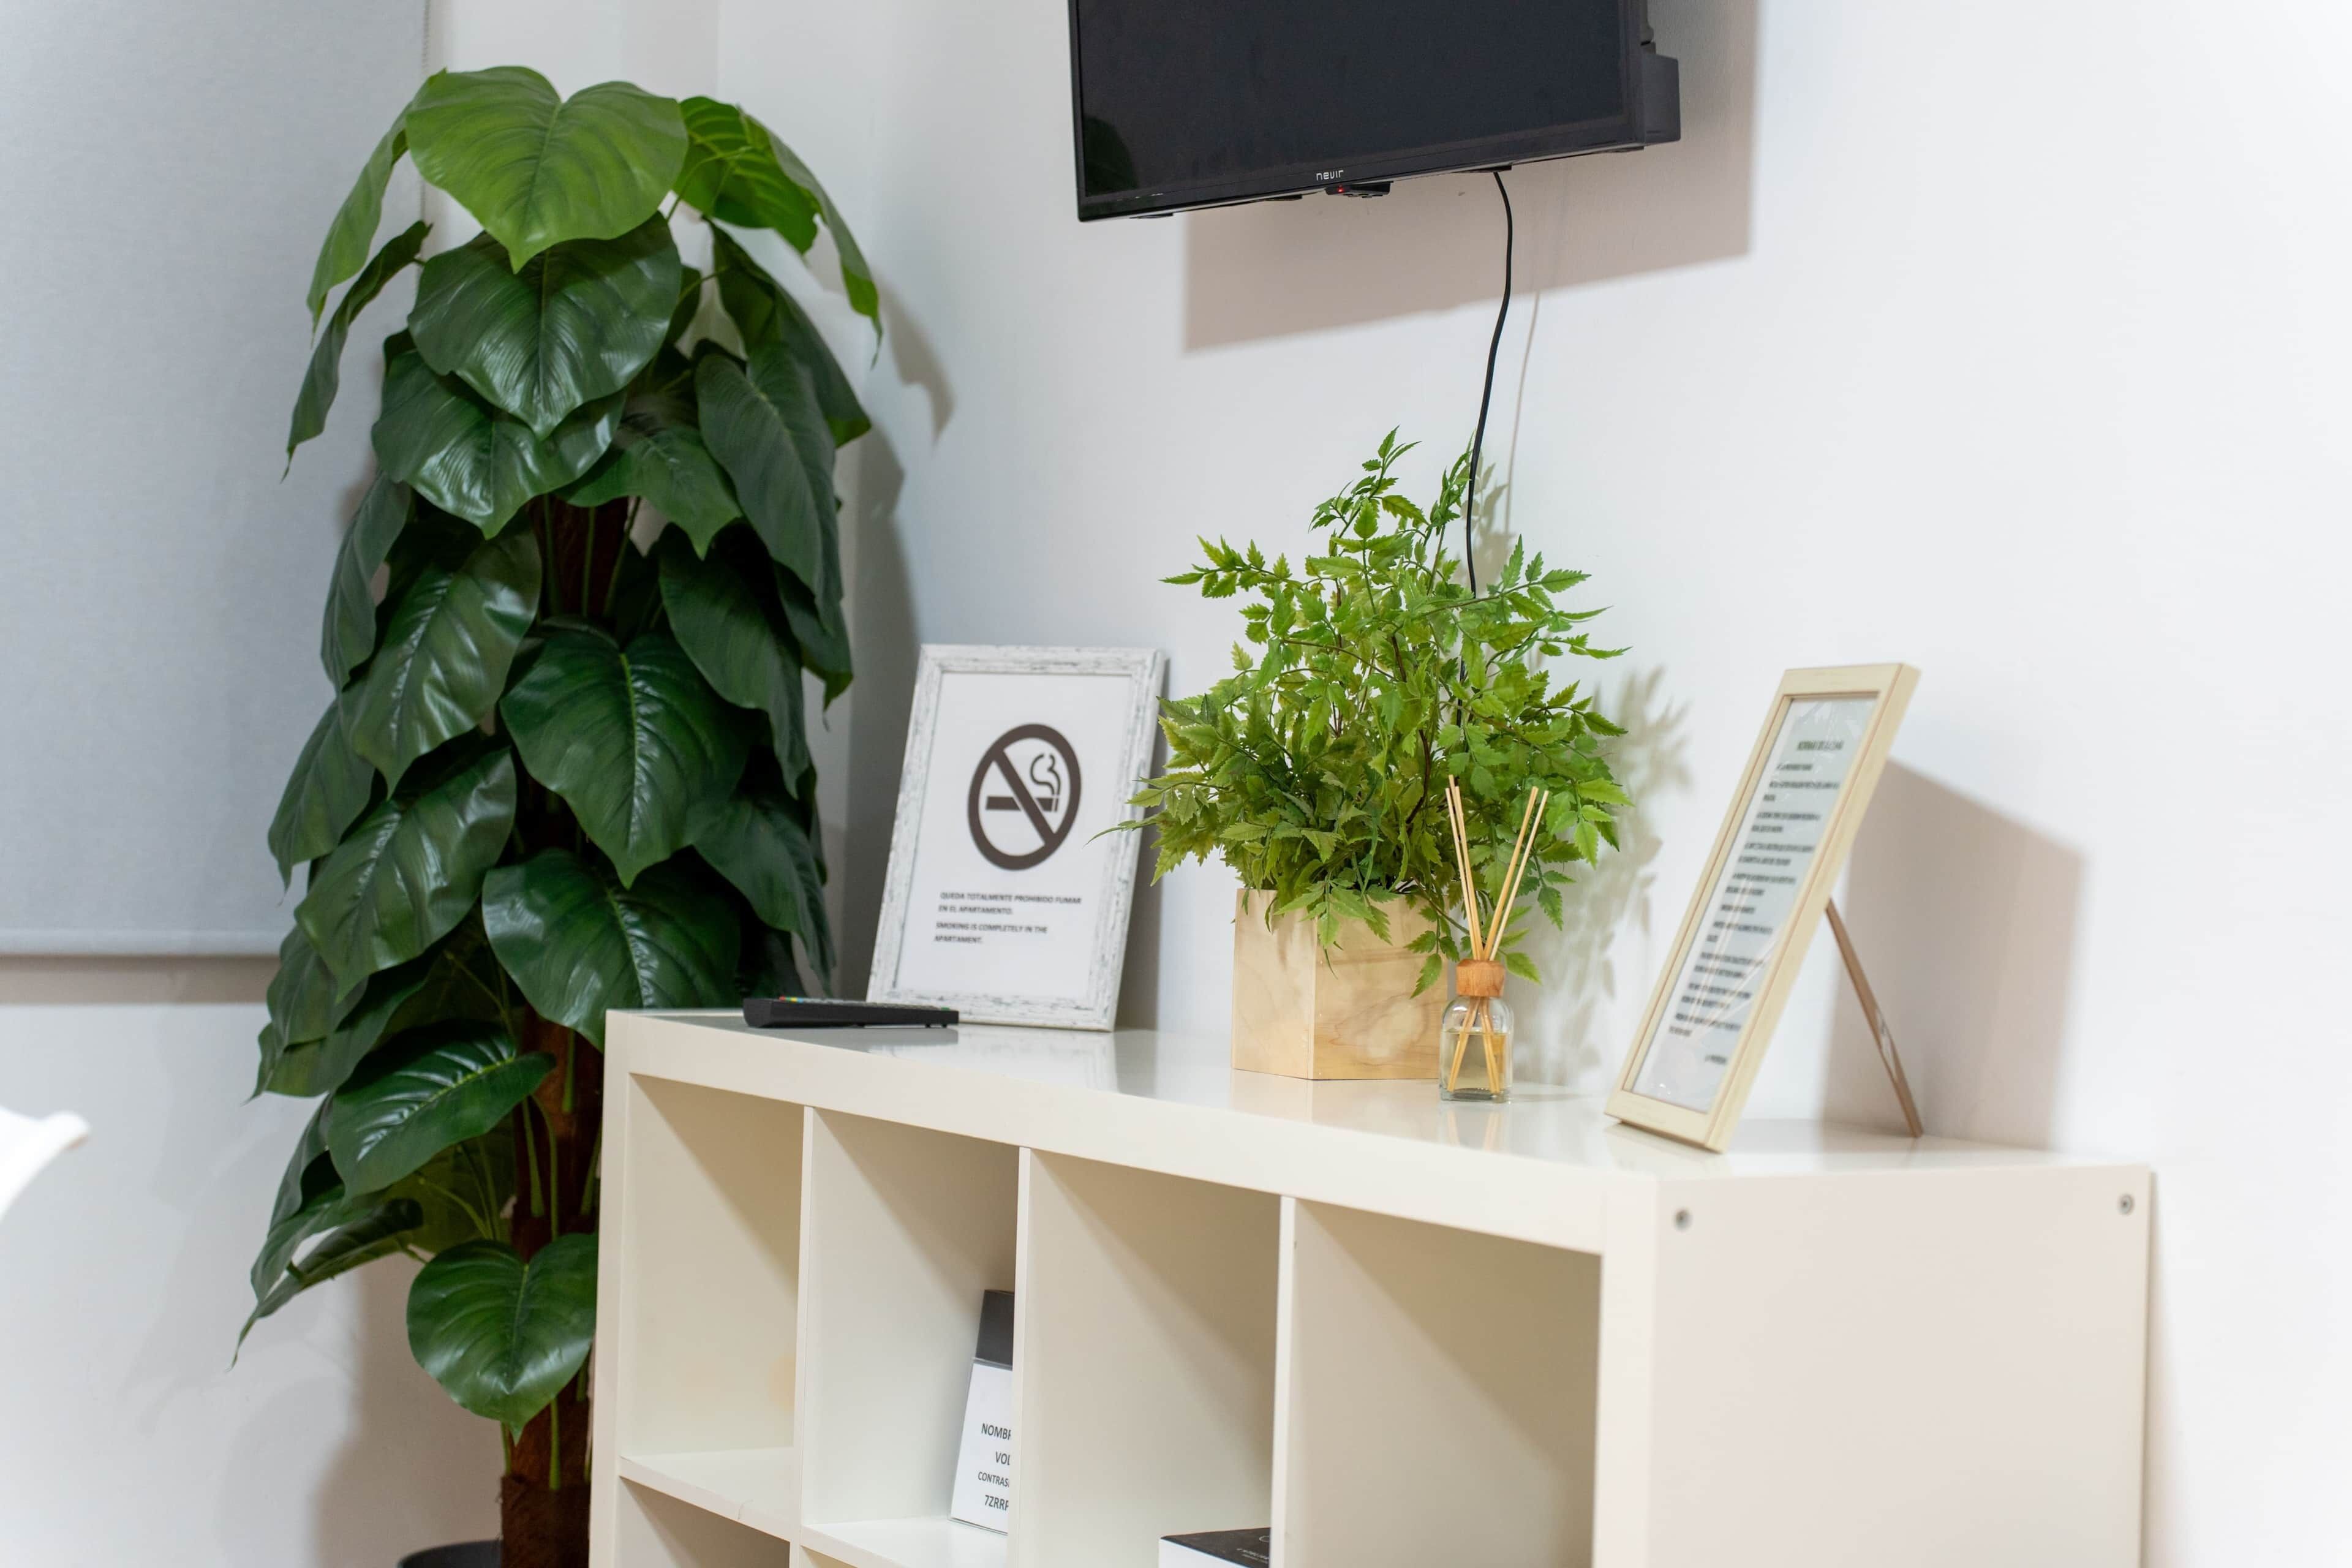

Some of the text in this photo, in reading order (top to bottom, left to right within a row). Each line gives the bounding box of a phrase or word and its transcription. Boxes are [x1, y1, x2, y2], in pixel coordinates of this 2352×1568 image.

[1316, 170, 1344, 181] nevir
[940, 892, 965, 900] QUEDA
[967, 893, 1012, 902] TOTALMENTE
[1014, 895, 1053, 903] PROHIBIDO
[936, 922, 969, 930] SMOKING
[978, 924, 1023, 933] COMPLETELY
[978, 1471, 1009, 1488] CONTRAS
